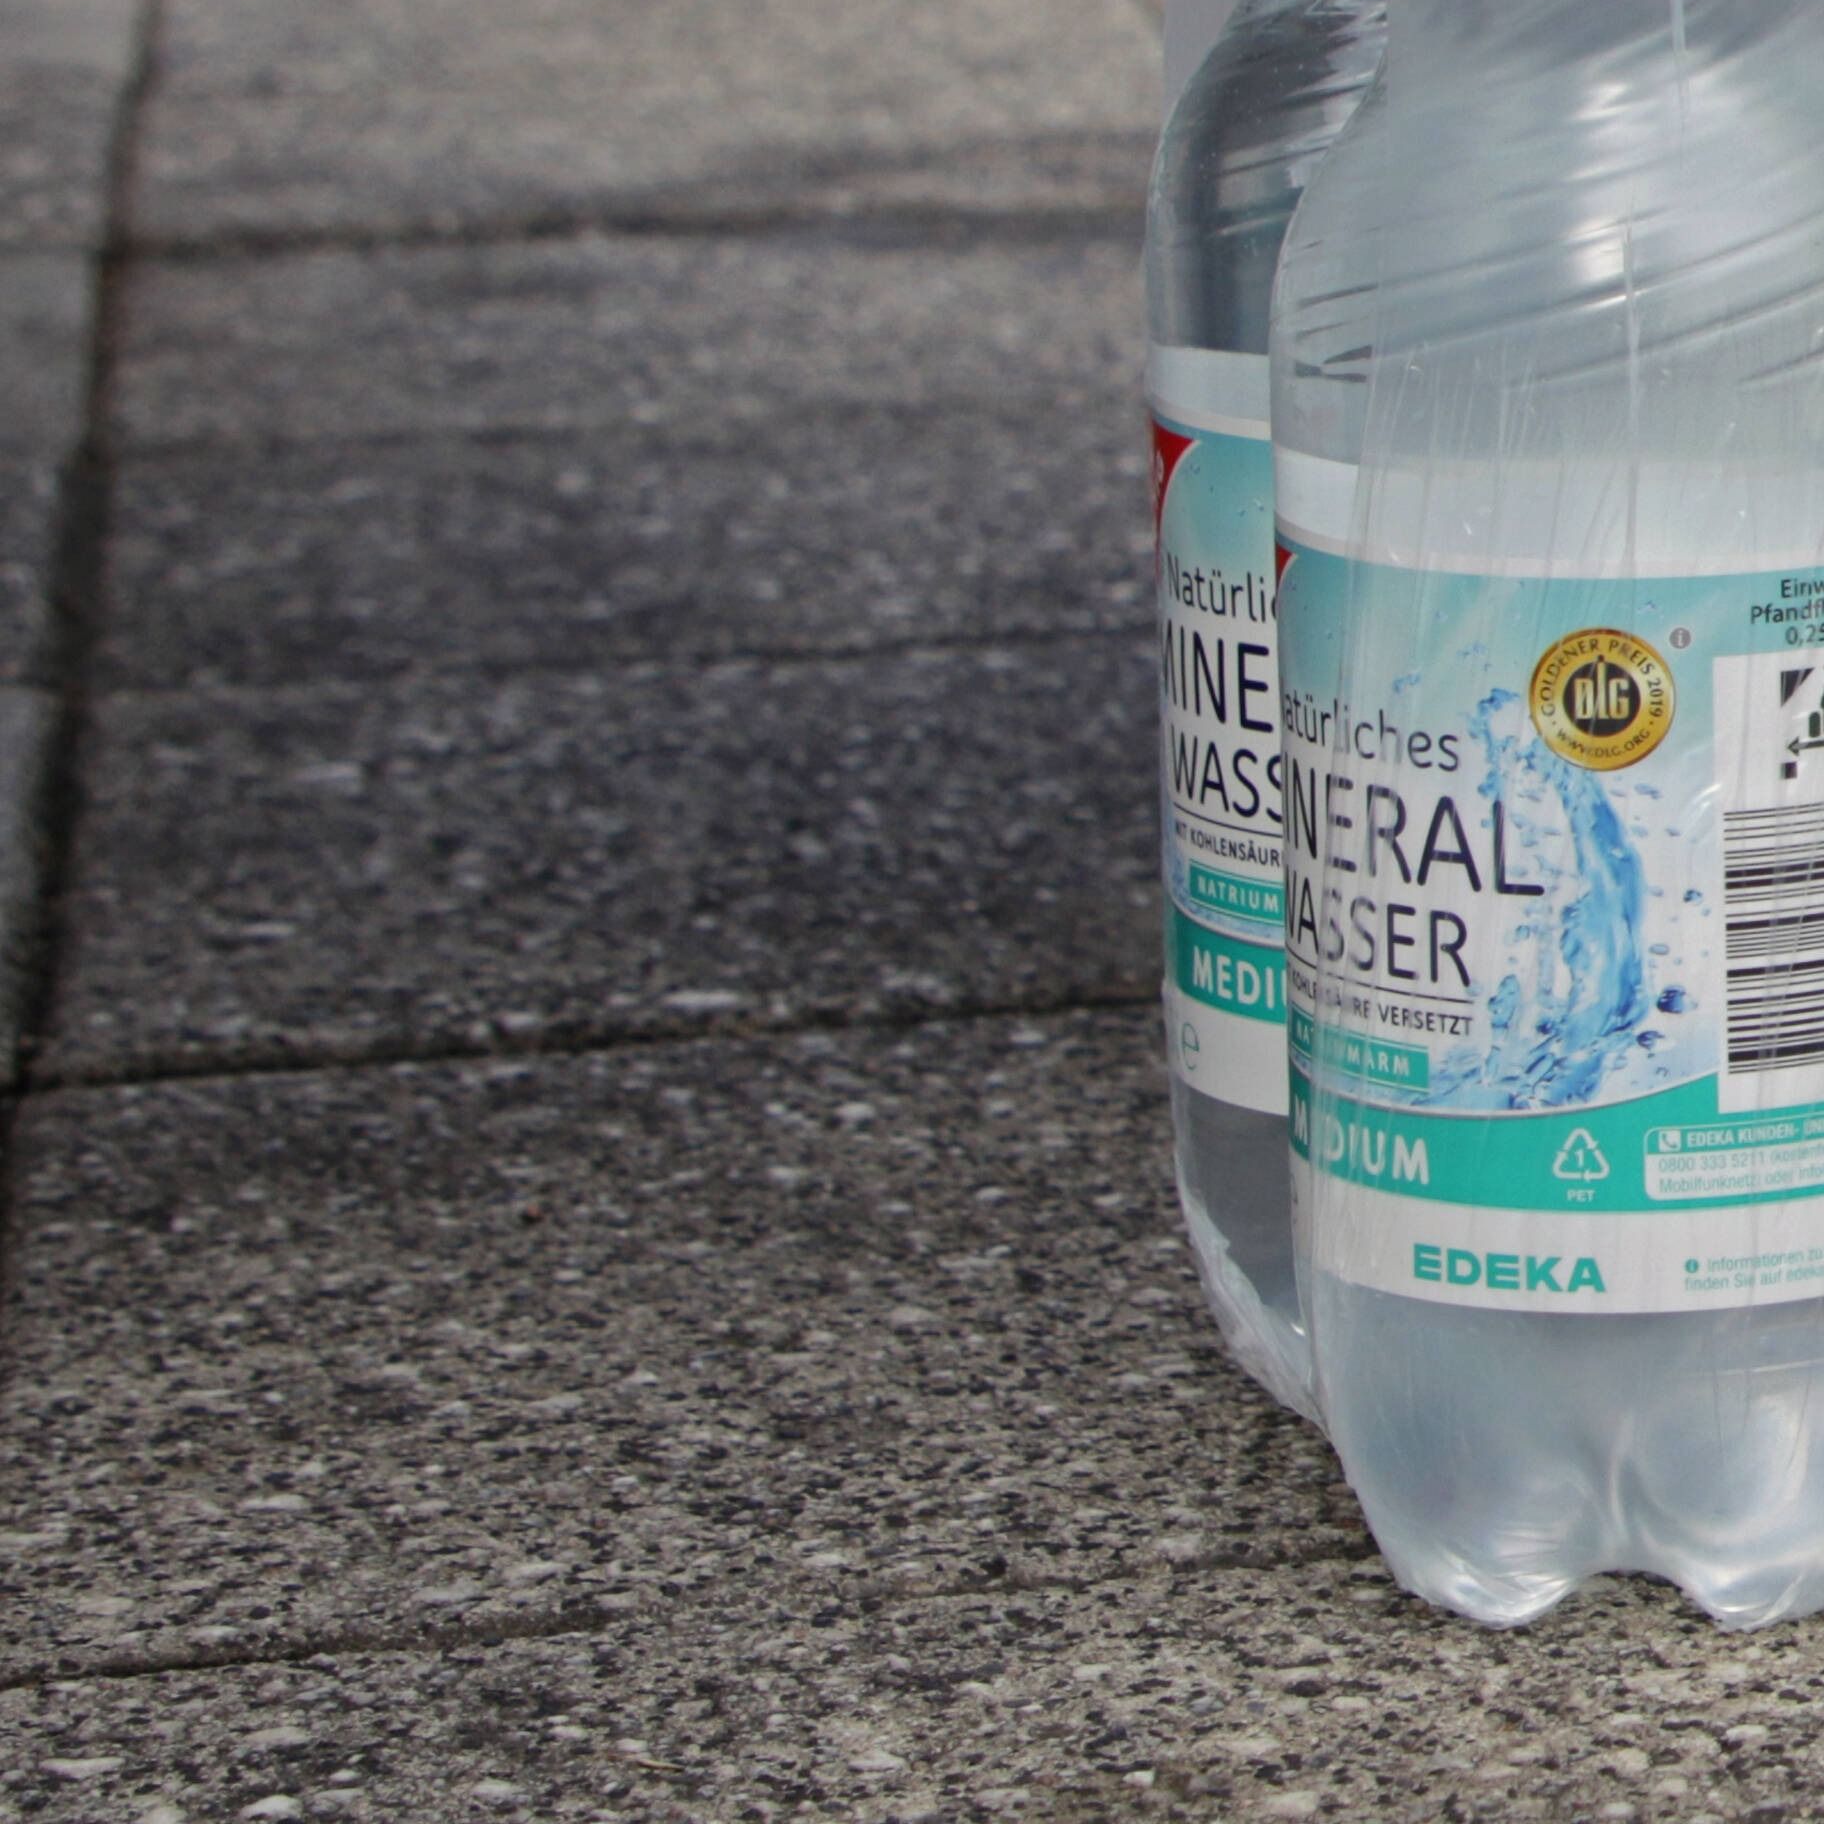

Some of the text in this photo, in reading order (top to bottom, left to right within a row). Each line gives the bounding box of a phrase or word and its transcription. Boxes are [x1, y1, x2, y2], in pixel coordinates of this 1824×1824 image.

[1647, 679, 1665, 718] 2019
[1282, 690, 1460, 773] atürliches
[1378, 1004, 1474, 1037] VERSETZT
[1293, 1093, 1431, 1186] MDIUM
[1700, 1152, 1727, 1171] 333
[1412, 1242, 1607, 1294] EDEKA
[1706, 1249, 1805, 1274] Informationen
[1683, 1272, 1730, 1293] finden
[1759, 1268, 1784, 1286] auf
